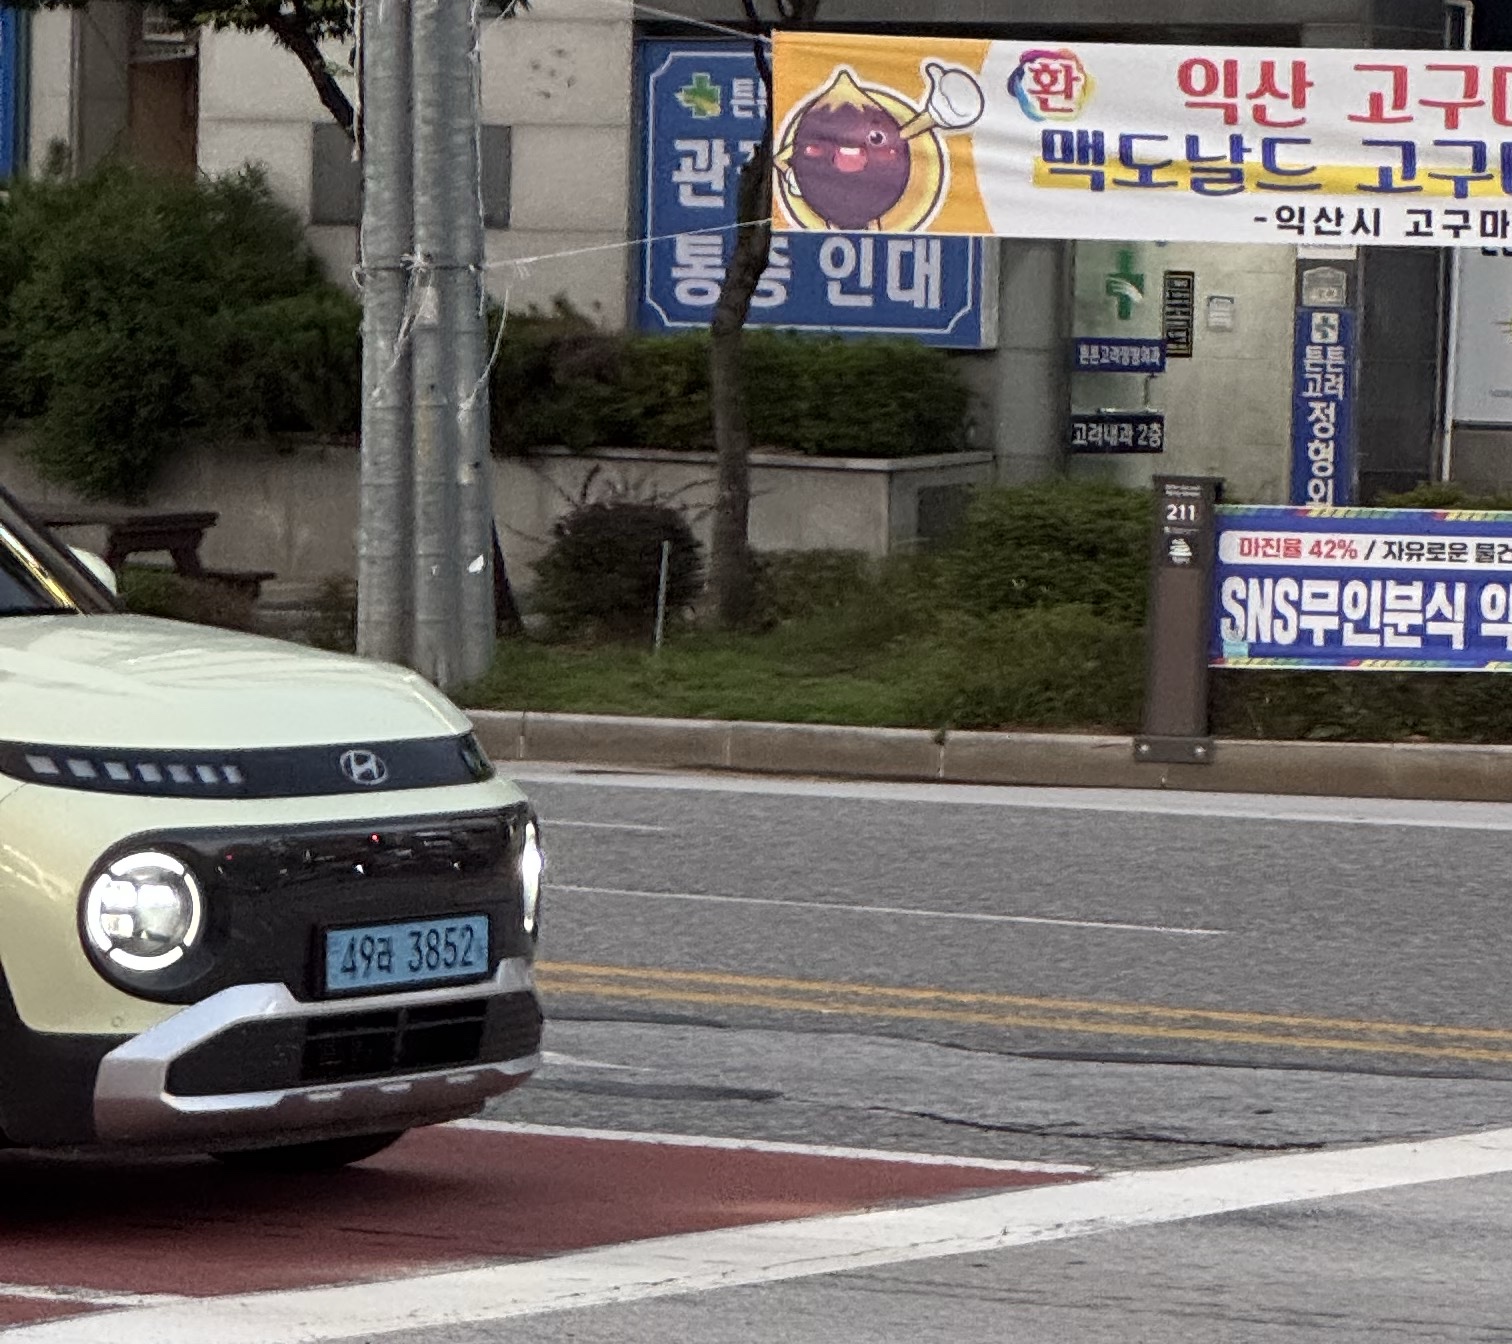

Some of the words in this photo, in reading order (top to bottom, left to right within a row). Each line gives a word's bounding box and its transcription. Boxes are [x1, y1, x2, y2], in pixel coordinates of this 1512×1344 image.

[1027, 63, 1080, 114] 환
[1176, 57, 1314, 128] 익산
[1040, 128, 1323, 196] 맥도날드
[1404, 208, 1511, 240] 고구마
[818, 236, 942, 309] 인대
[1303, 345, 1346, 373] 튼튼
[1302, 373, 1345, 401] 고려
[1072, 422, 1134, 447] 고려내과
[1137, 422, 1162, 448] 2층
[1166, 503, 1196, 523] 211
[1308, 538, 1358, 560] 42%
[1383, 541, 1468, 563] 자유로운
[1219, 575, 1468, 651] SNS무인분식
[407, 923, 475, 973] 3852
